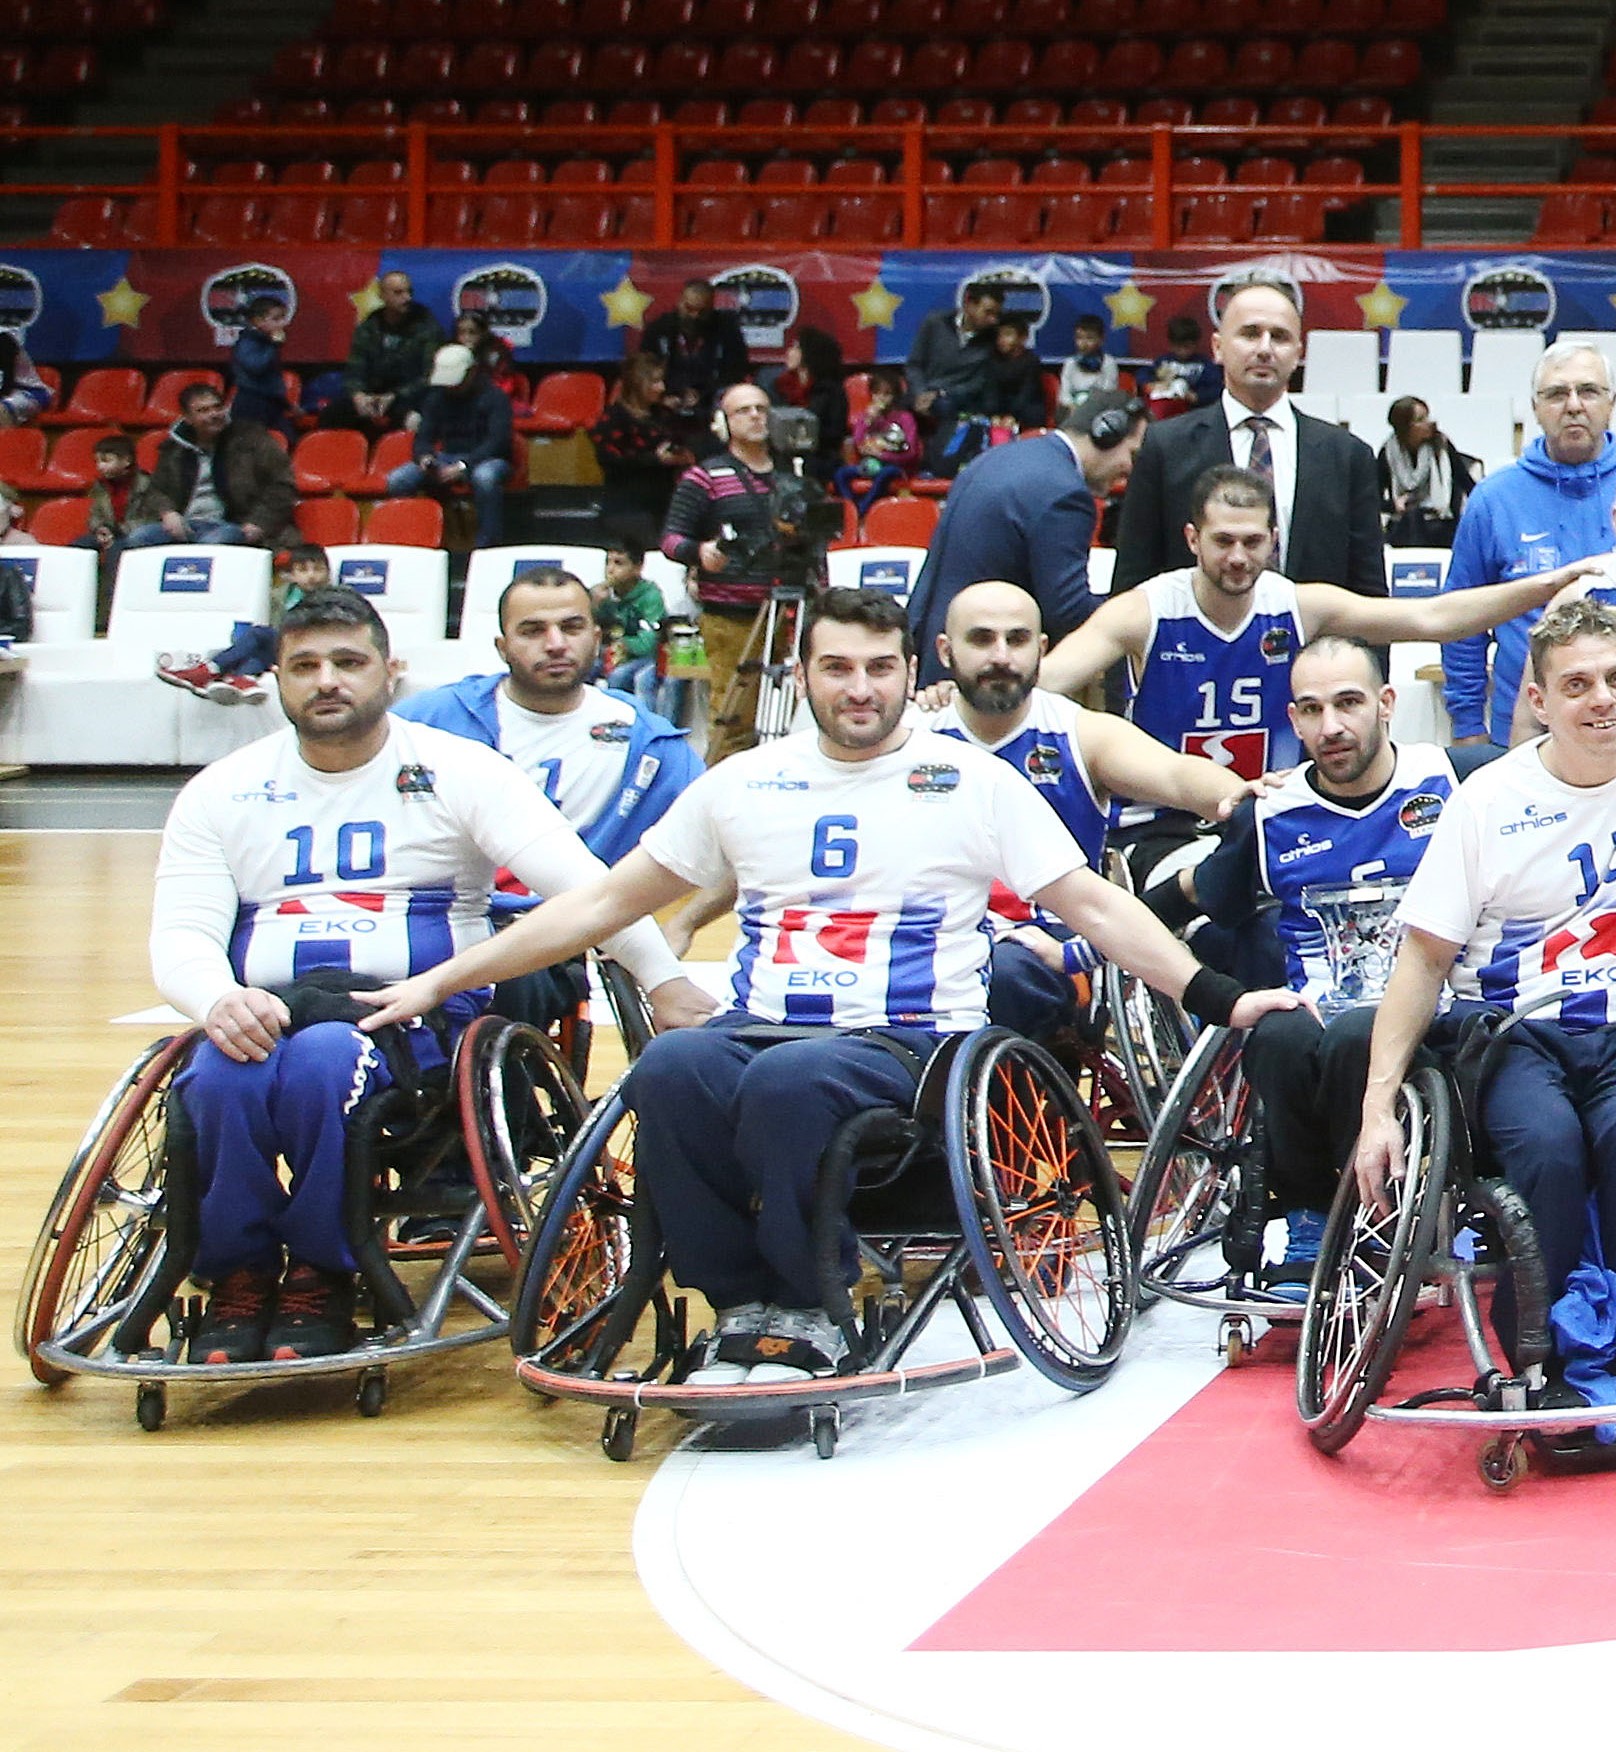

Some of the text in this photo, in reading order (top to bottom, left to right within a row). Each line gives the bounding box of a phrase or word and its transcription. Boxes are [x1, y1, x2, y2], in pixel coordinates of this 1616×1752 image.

[1195, 677, 1262, 727] 15
[284, 820, 385, 886] 10
[812, 814, 857, 878] 6
[298, 918, 378, 934] EKO
[787, 970, 858, 988] EKO
